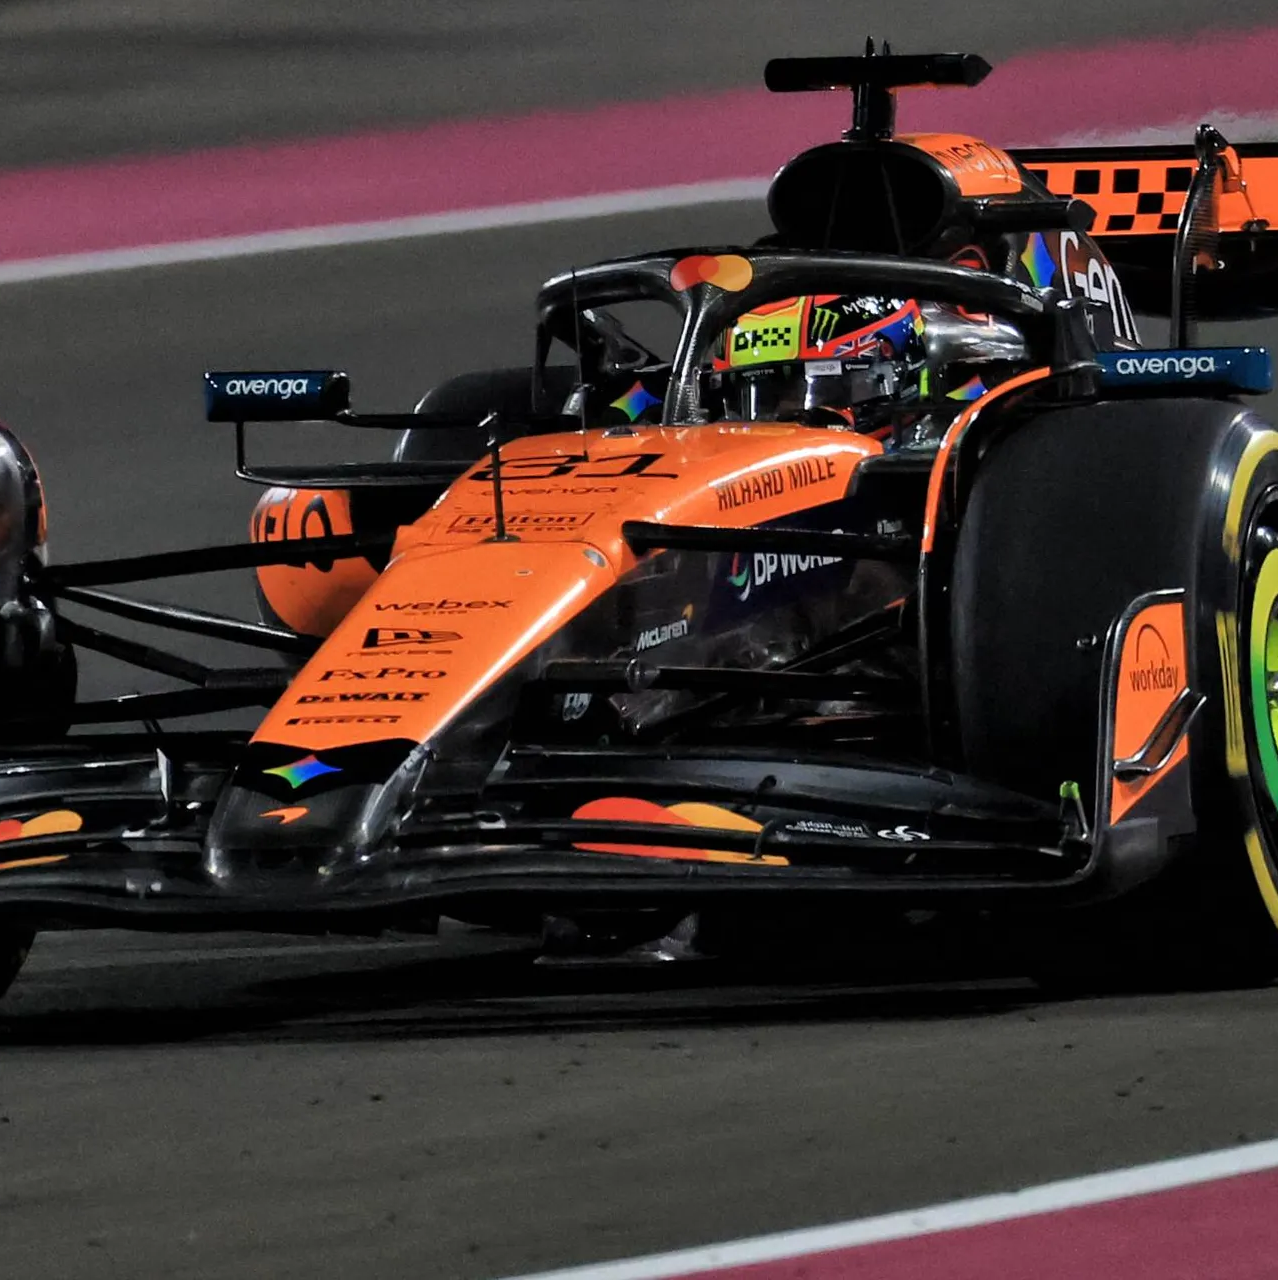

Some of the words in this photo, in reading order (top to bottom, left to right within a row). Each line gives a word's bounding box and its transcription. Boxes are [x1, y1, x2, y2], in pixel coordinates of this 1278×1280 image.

[1116, 354, 1216, 379] avenga
[226, 376, 309, 399] avenga
[715, 469, 785, 511] RICHARD
[787, 456, 837, 491] MILLE
[464, 514, 578, 525] Hlton
[754, 552, 778, 586] DP
[375, 599, 514, 612] webex
[636, 619, 688, 652] McLaren
[318, 667, 448, 682] FxPro
[1129, 662, 1179, 693] workday
